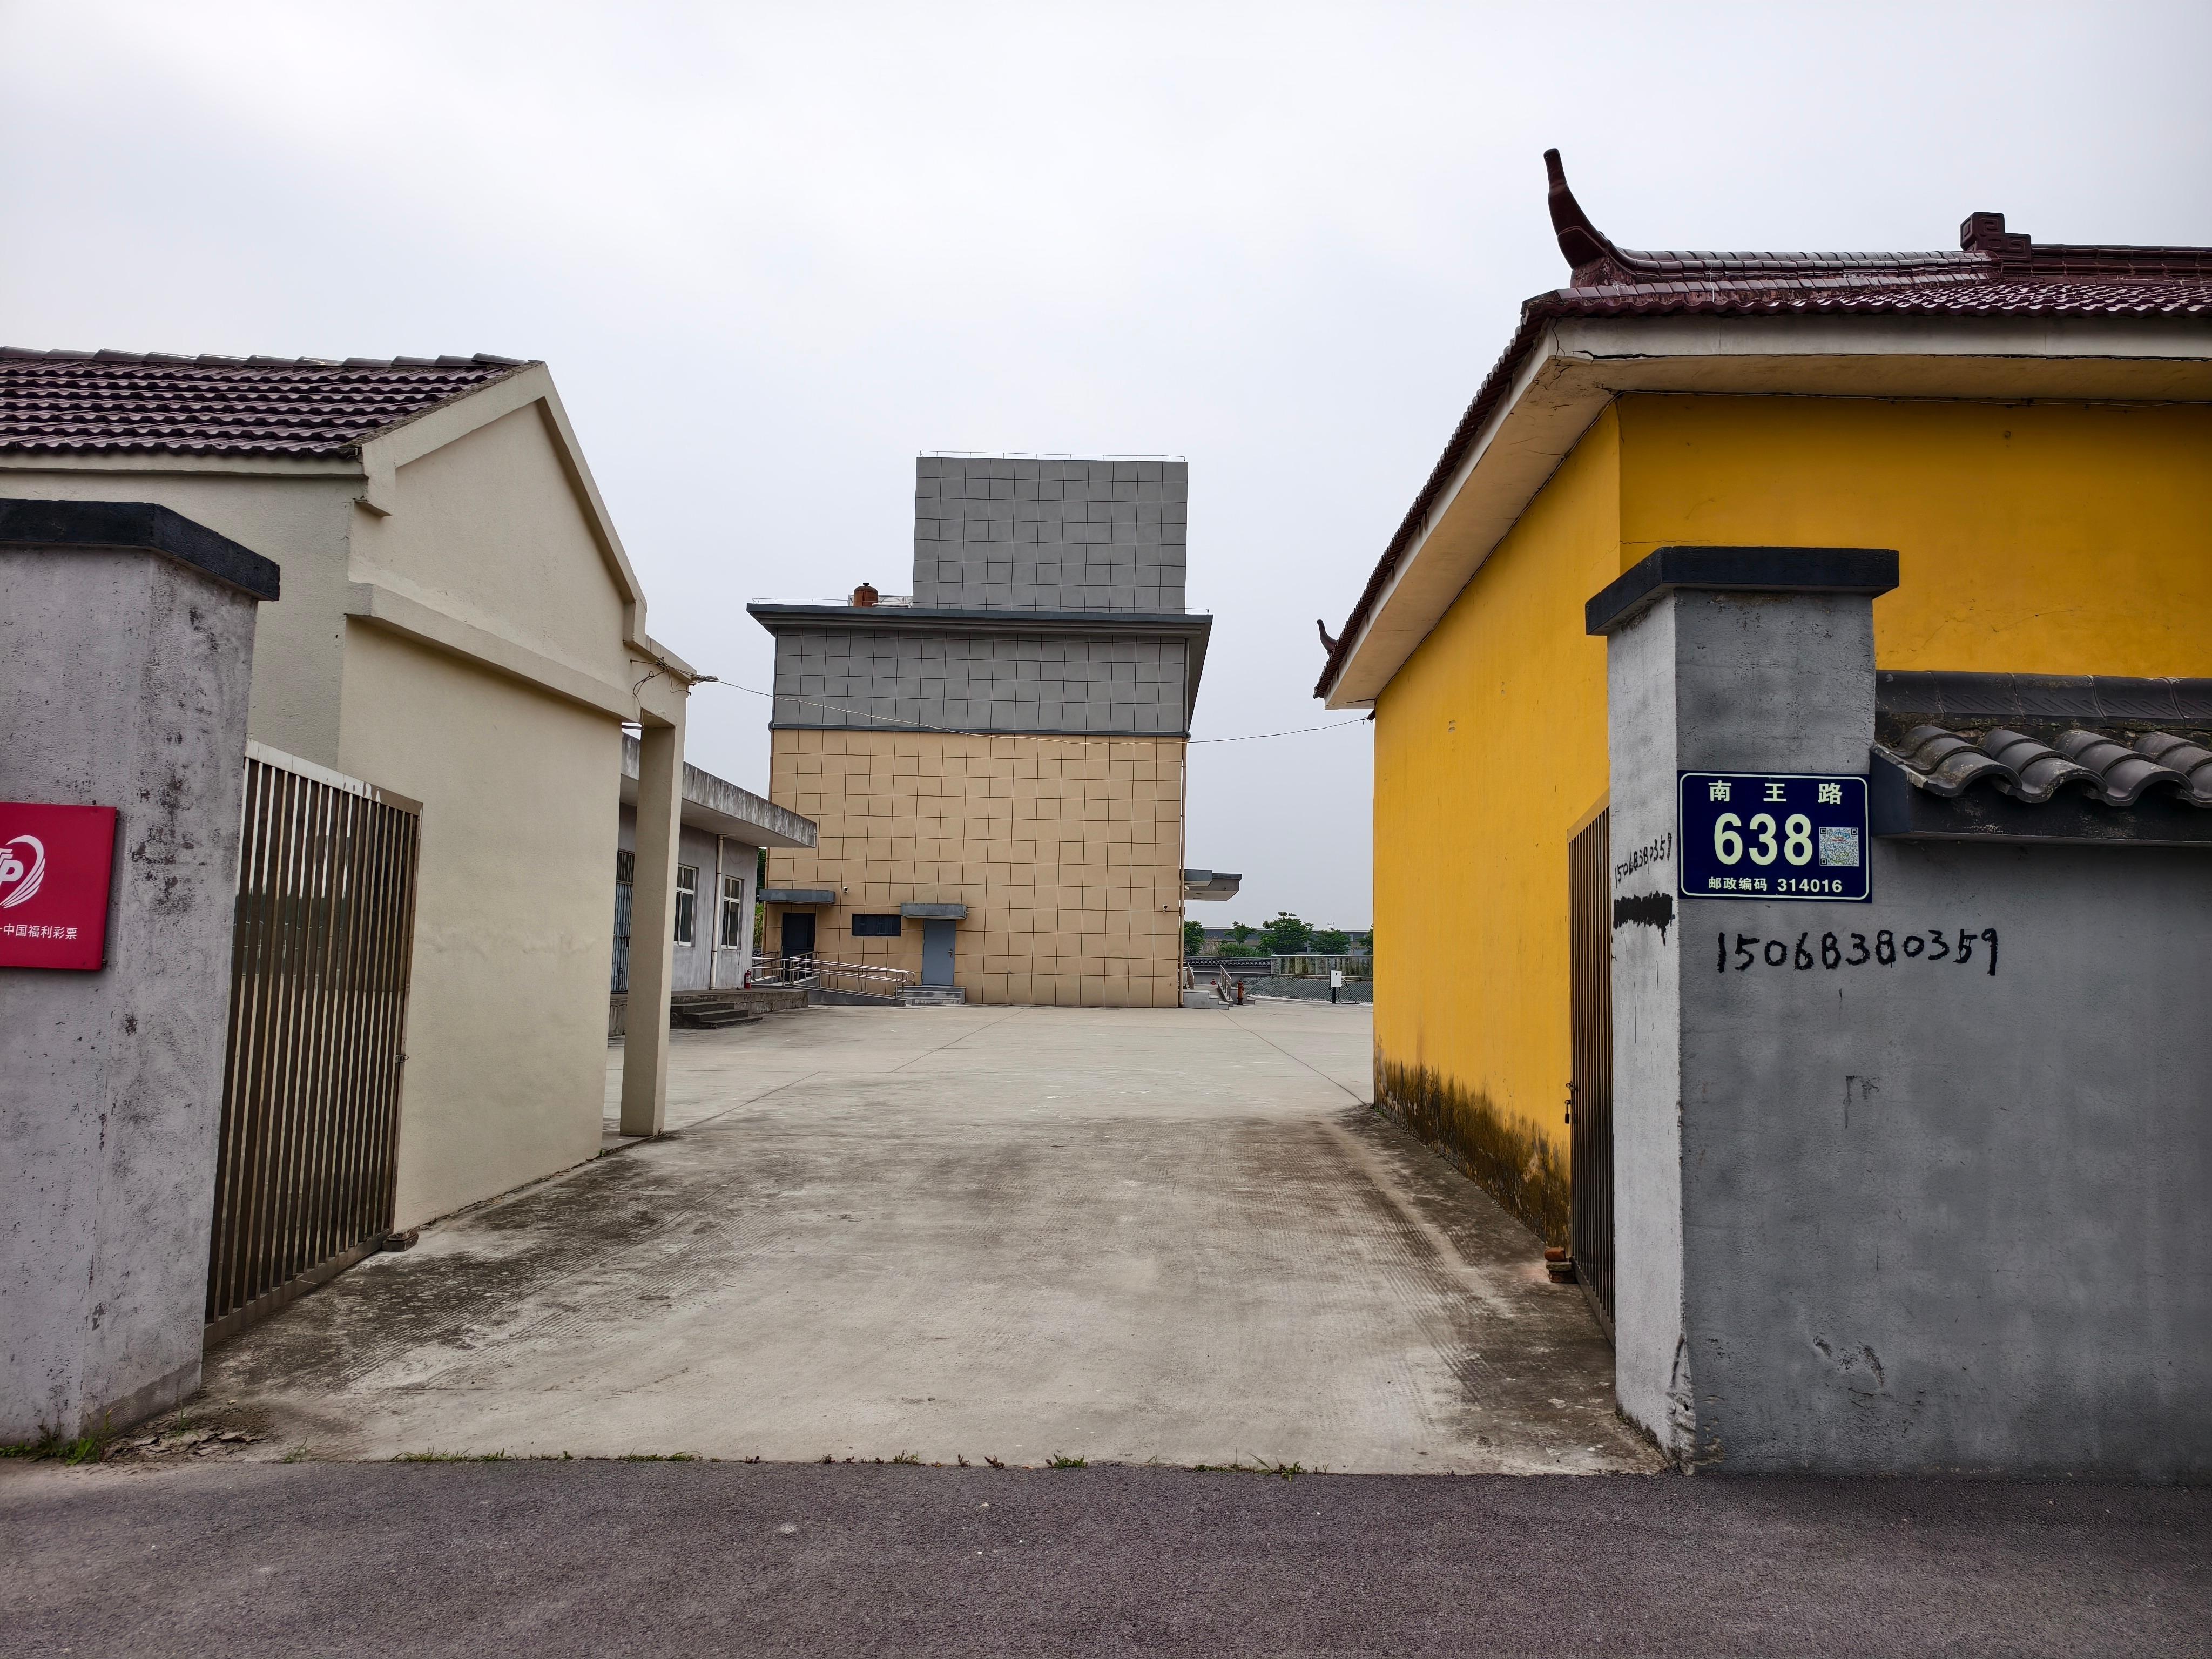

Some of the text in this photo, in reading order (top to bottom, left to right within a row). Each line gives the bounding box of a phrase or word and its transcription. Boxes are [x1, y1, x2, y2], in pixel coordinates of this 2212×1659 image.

[1708, 780, 1843, 805] 南王路
[1615, 832, 1672, 889] 15068380359
[1714, 813, 1813, 866] 638
[1708, 876, 1843, 893] 邮政编码 314016
[1717, 928, 1998, 976] 15068380359
